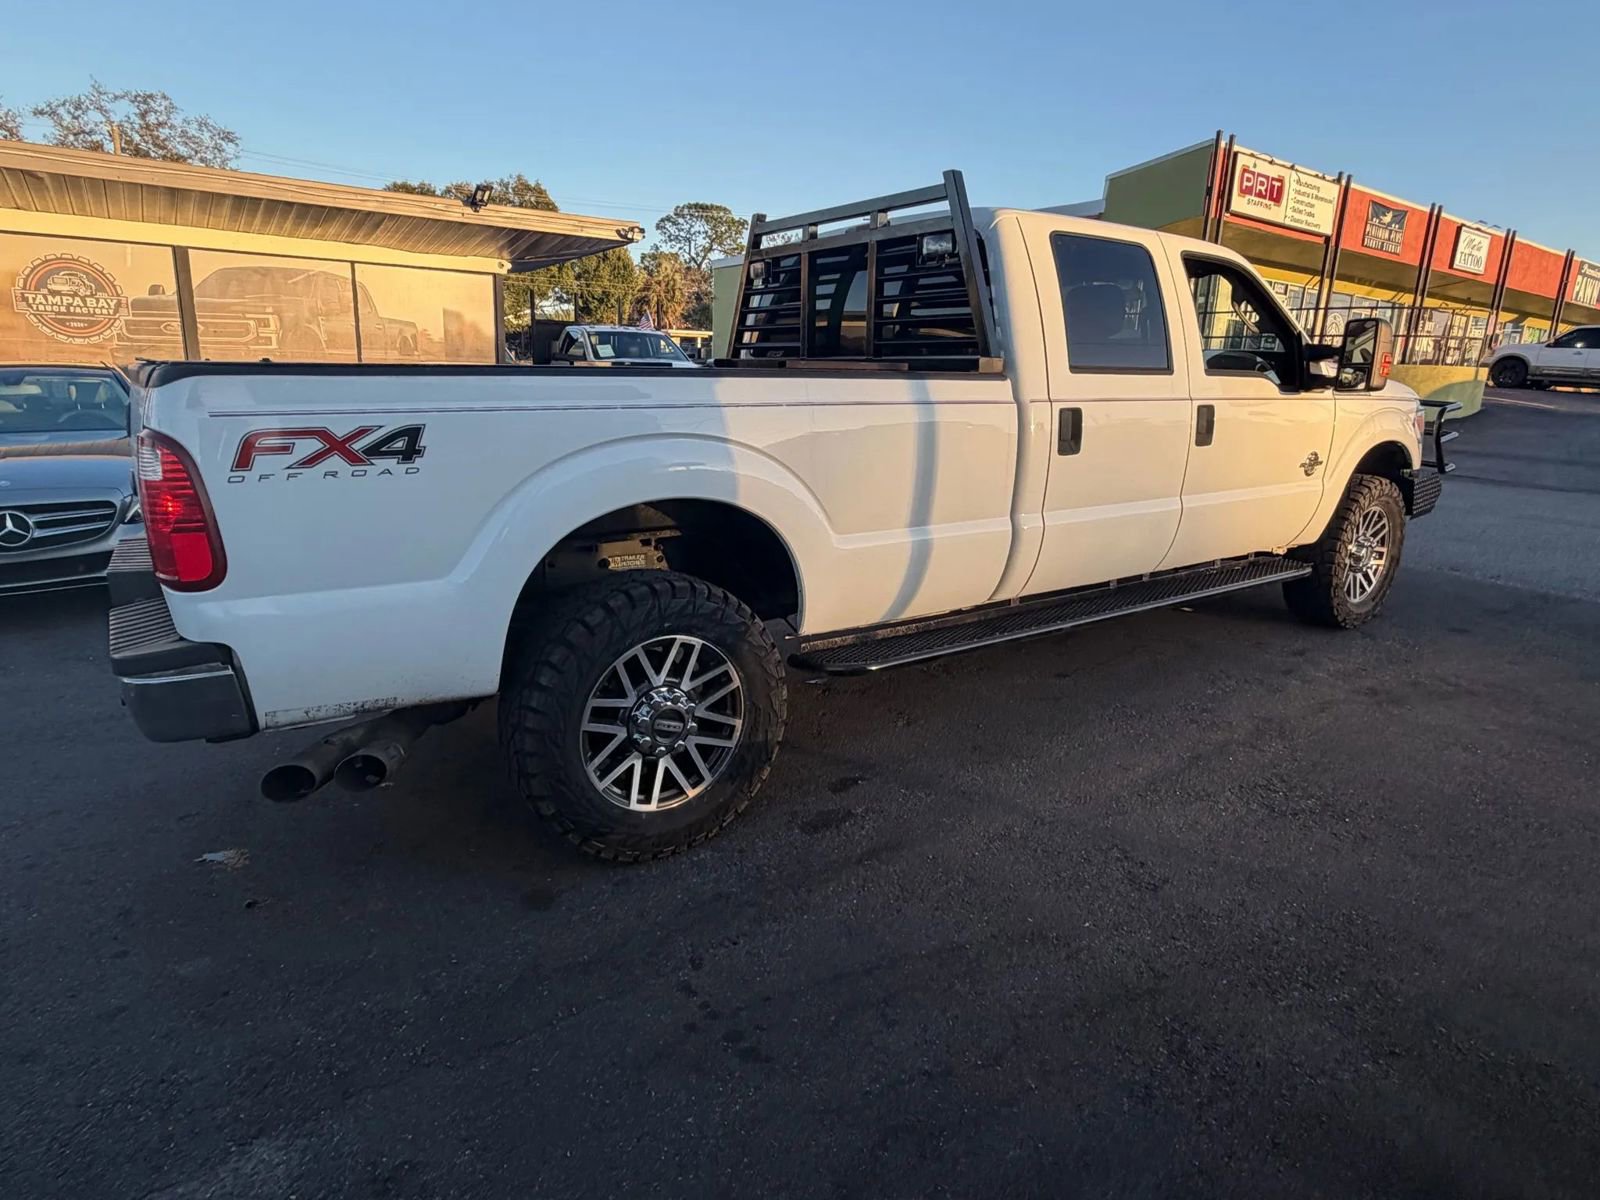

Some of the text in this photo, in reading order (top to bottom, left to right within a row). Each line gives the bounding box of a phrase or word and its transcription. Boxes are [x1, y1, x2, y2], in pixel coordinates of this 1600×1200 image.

[1242, 172, 1282, 199] PRT
[1247, 198, 1272, 210] STAFFING
[1390, 230, 1403, 243] PLUS
[1458, 251, 1483, 269] TATTOO
[1573, 275, 1600, 305] PAWN
[24, 293, 83, 307] TAMPA
[85, 297, 119, 309] BAY
[31, 304, 115, 315] TRUCK FACTORY
[230, 423, 426, 472] FX4
[227, 466, 421, 484] OFF ROAD
